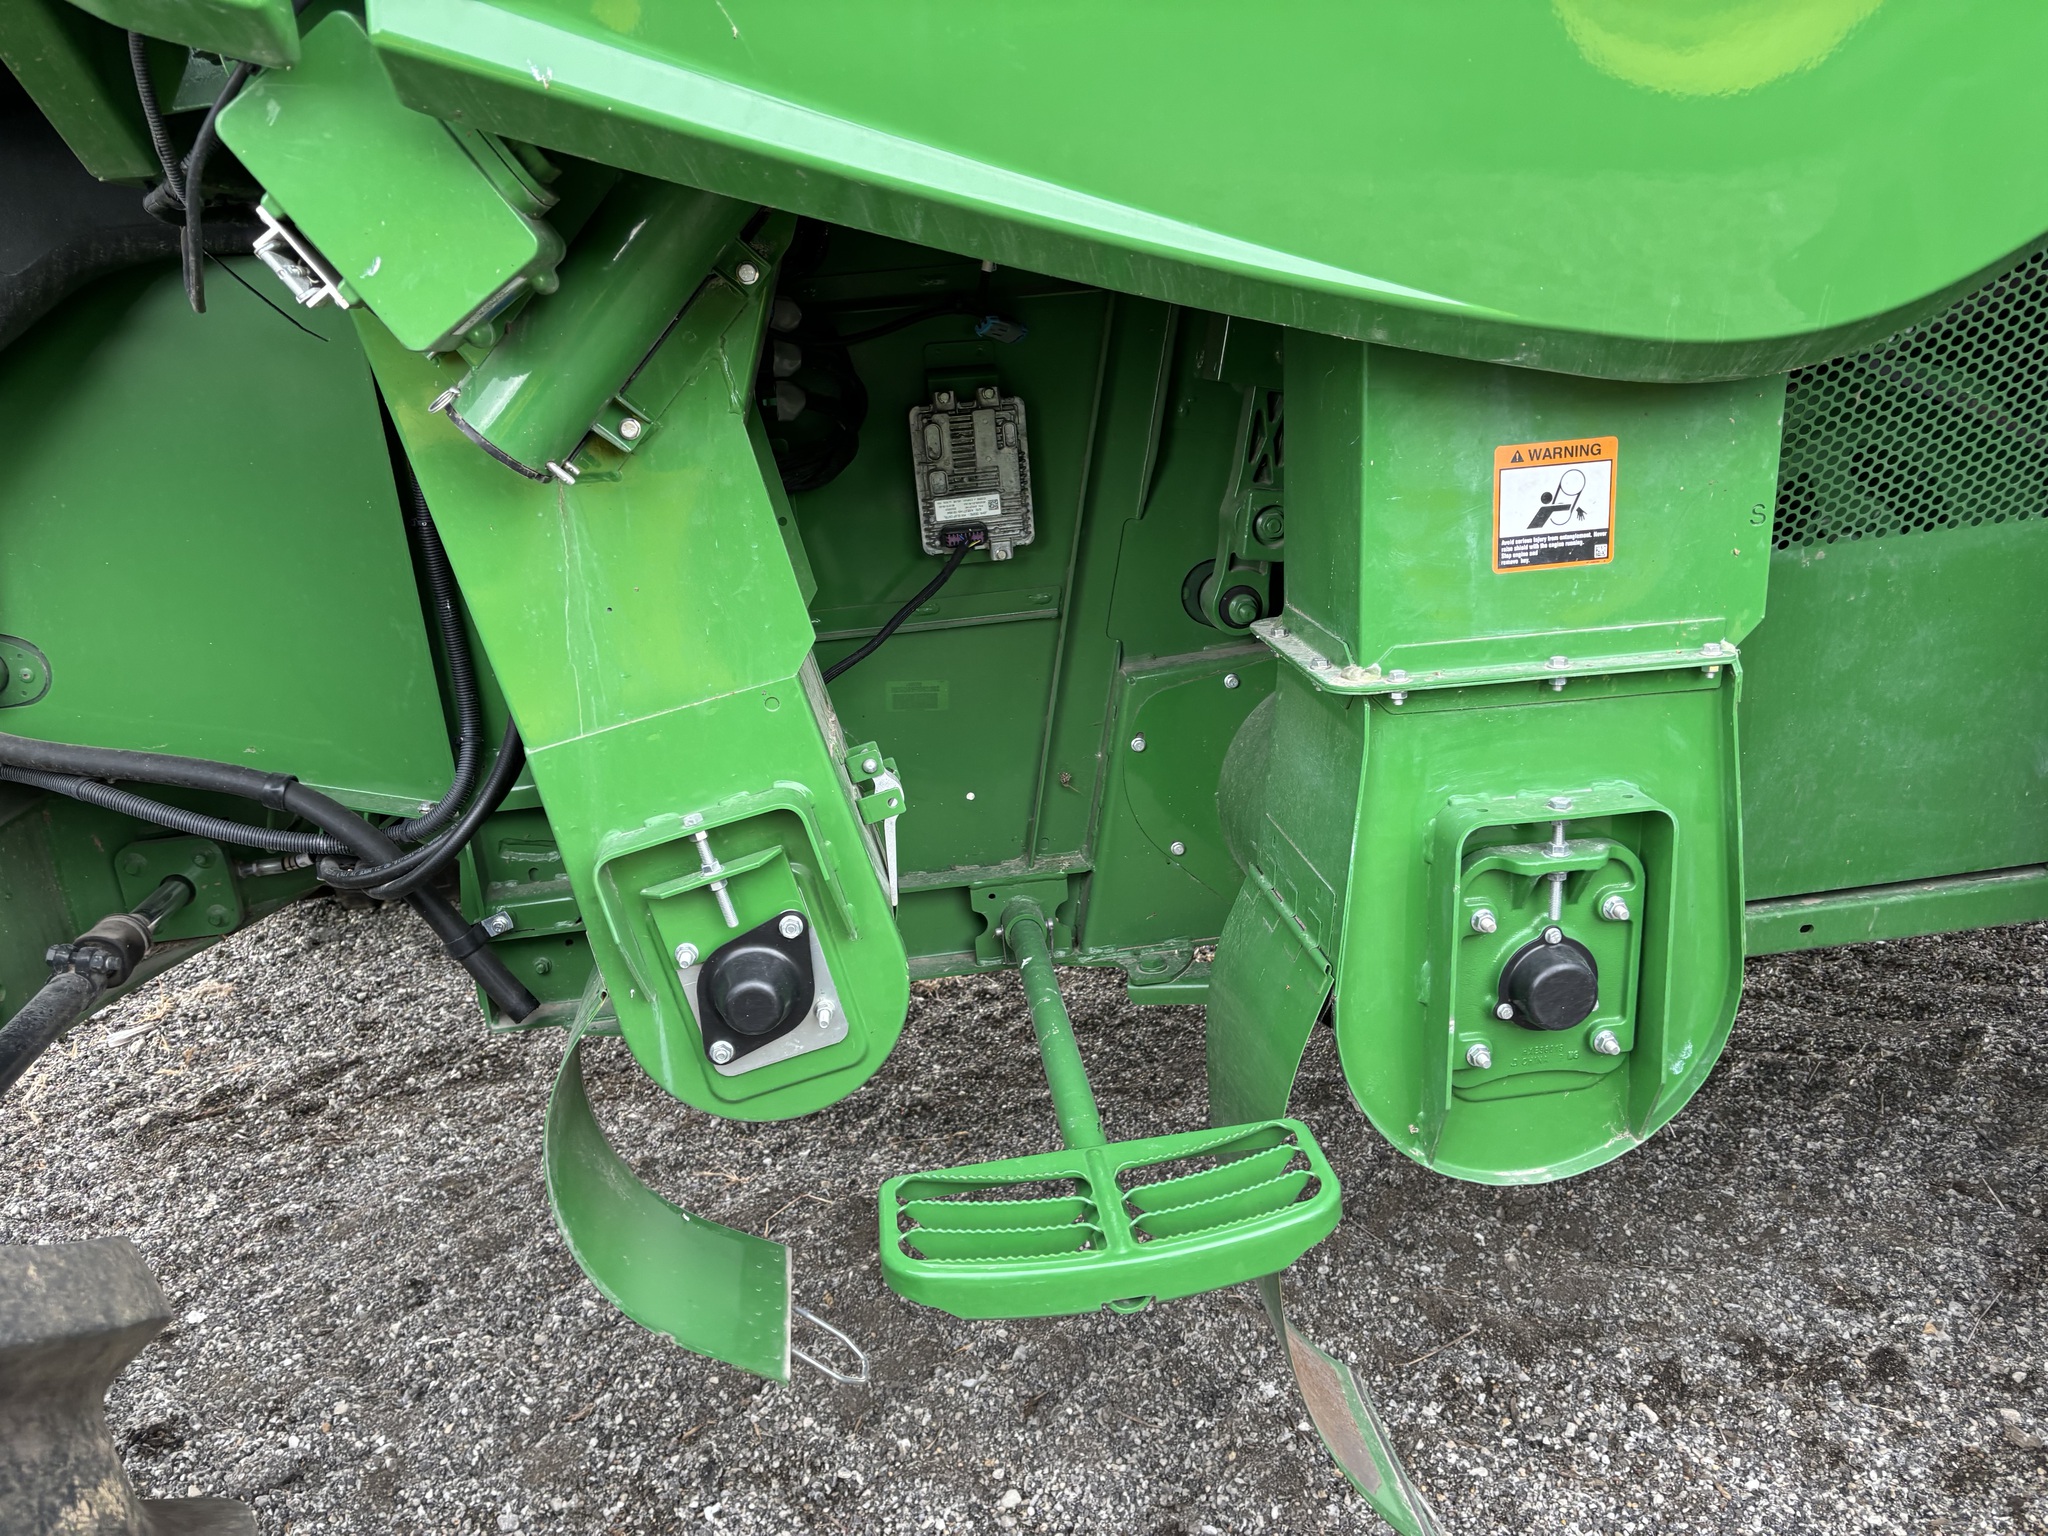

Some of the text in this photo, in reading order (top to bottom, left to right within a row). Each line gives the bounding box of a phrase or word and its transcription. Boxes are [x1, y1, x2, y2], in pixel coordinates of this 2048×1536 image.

[1528, 443, 1602, 461] WARNING
[1750, 504, 1766, 525] S
[1533, 536, 1547, 544] injury
[1560, 532, 1592, 540] entanglement.
[1548, 541, 1564, 549] engine
[1529, 549, 1539, 557] and
